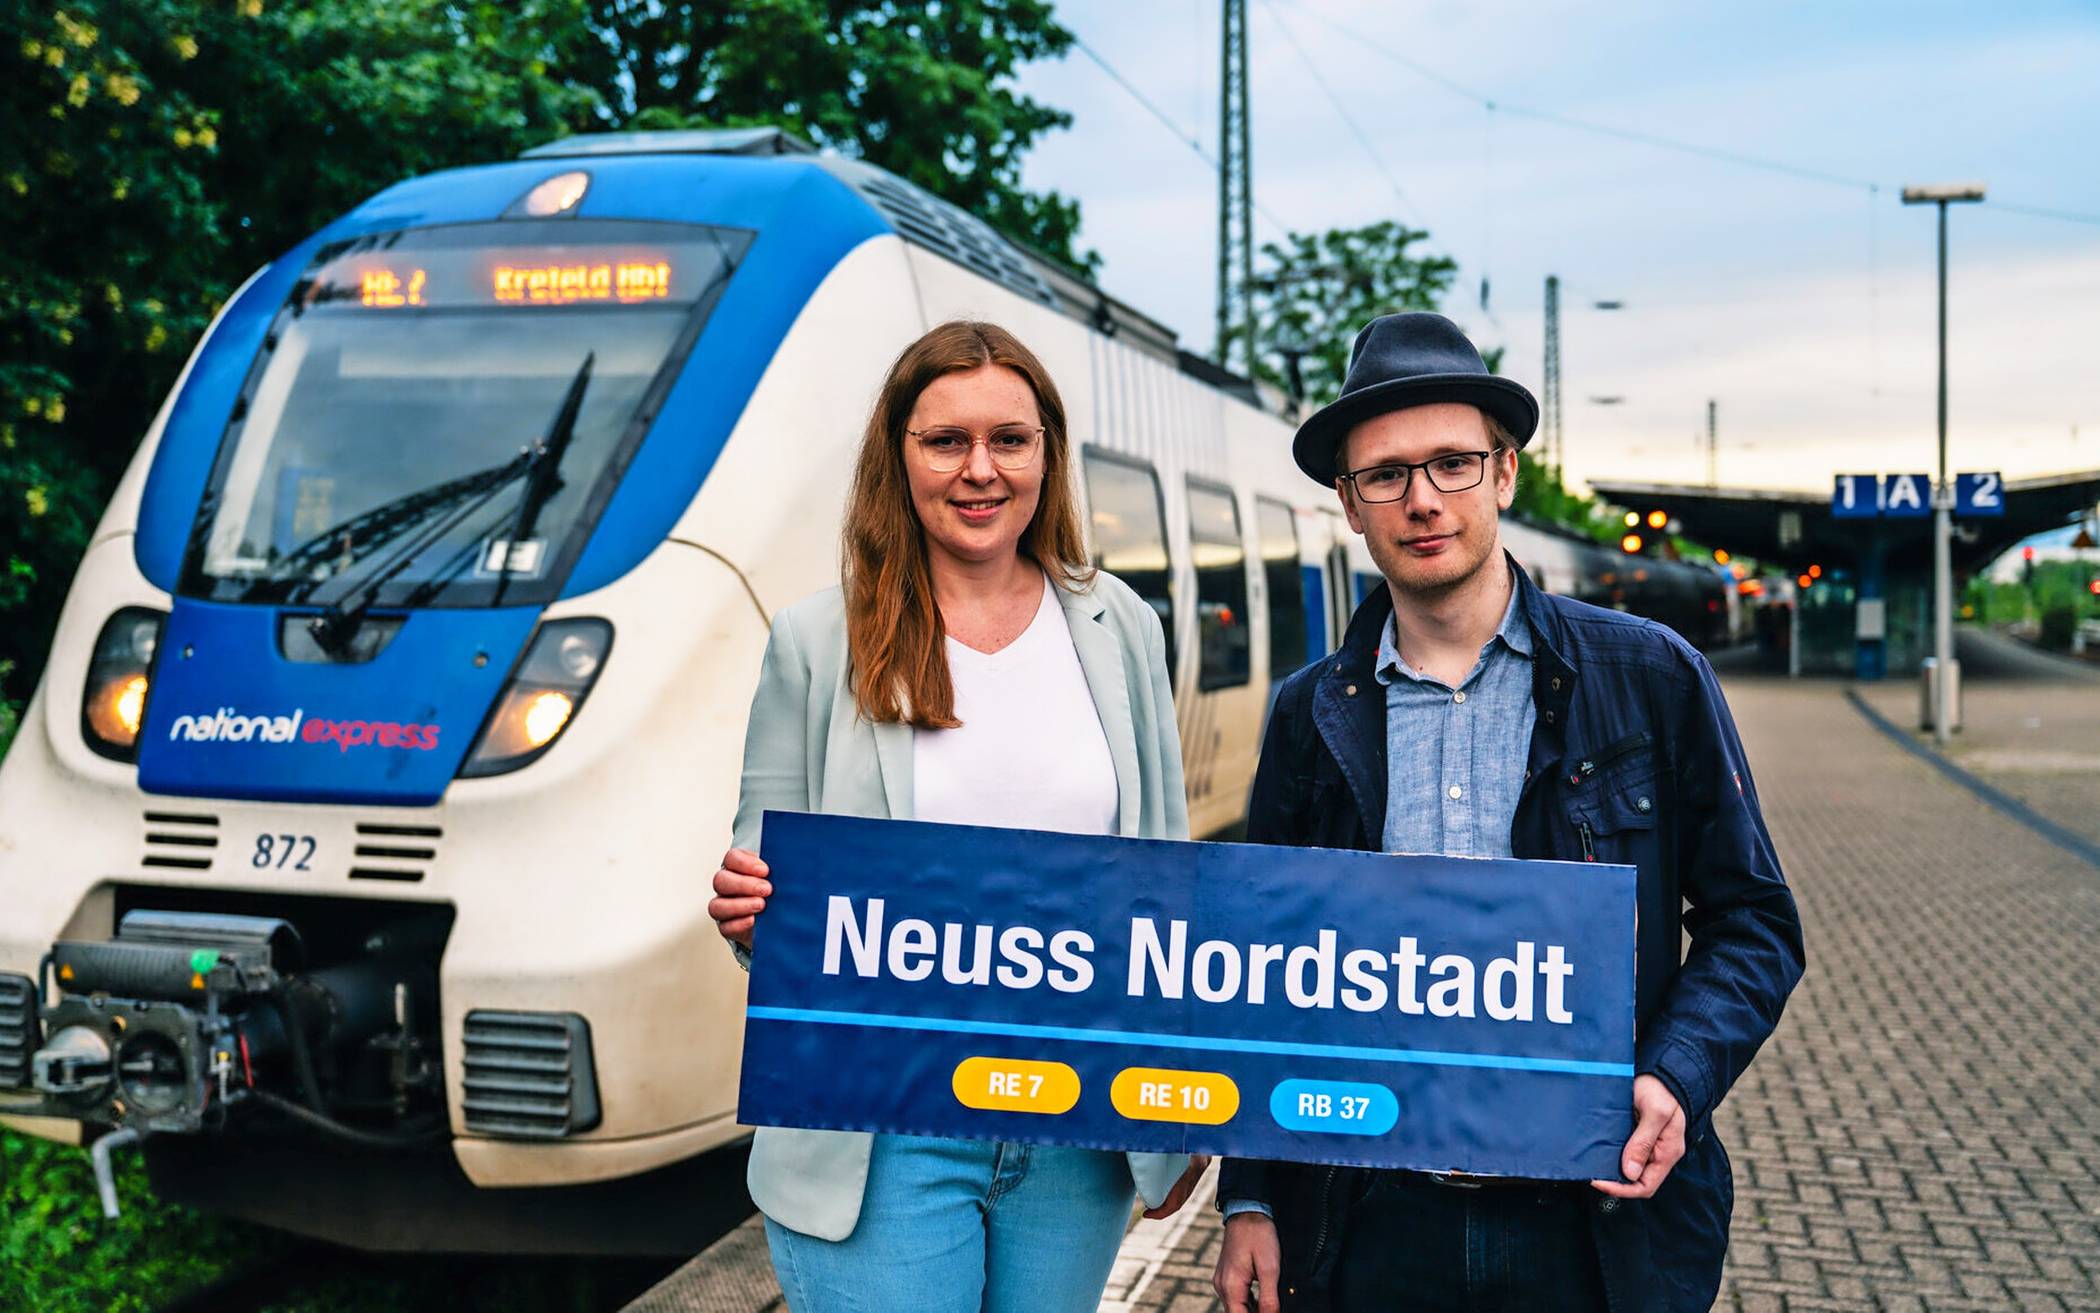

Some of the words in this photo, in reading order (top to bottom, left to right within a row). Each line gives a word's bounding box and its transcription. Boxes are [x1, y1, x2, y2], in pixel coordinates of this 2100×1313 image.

[1837, 476, 1855, 510] 1
[1888, 475, 1921, 510] A
[1971, 473, 2000, 508] 2
[169, 706, 304, 743] national
[301, 717, 441, 753] express
[252, 832, 318, 872] 872
[822, 895, 1095, 993] Neuss
[1127, 916, 1574, 1024] Nordstadt
[988, 1071, 1021, 1098] RE
[1027, 1074, 1044, 1099] 7
[1139, 1082, 1172, 1109] RE
[1179, 1085, 1210, 1111] 10
[1297, 1092, 1333, 1118] RB
[1339, 1096, 1371, 1121] 37
